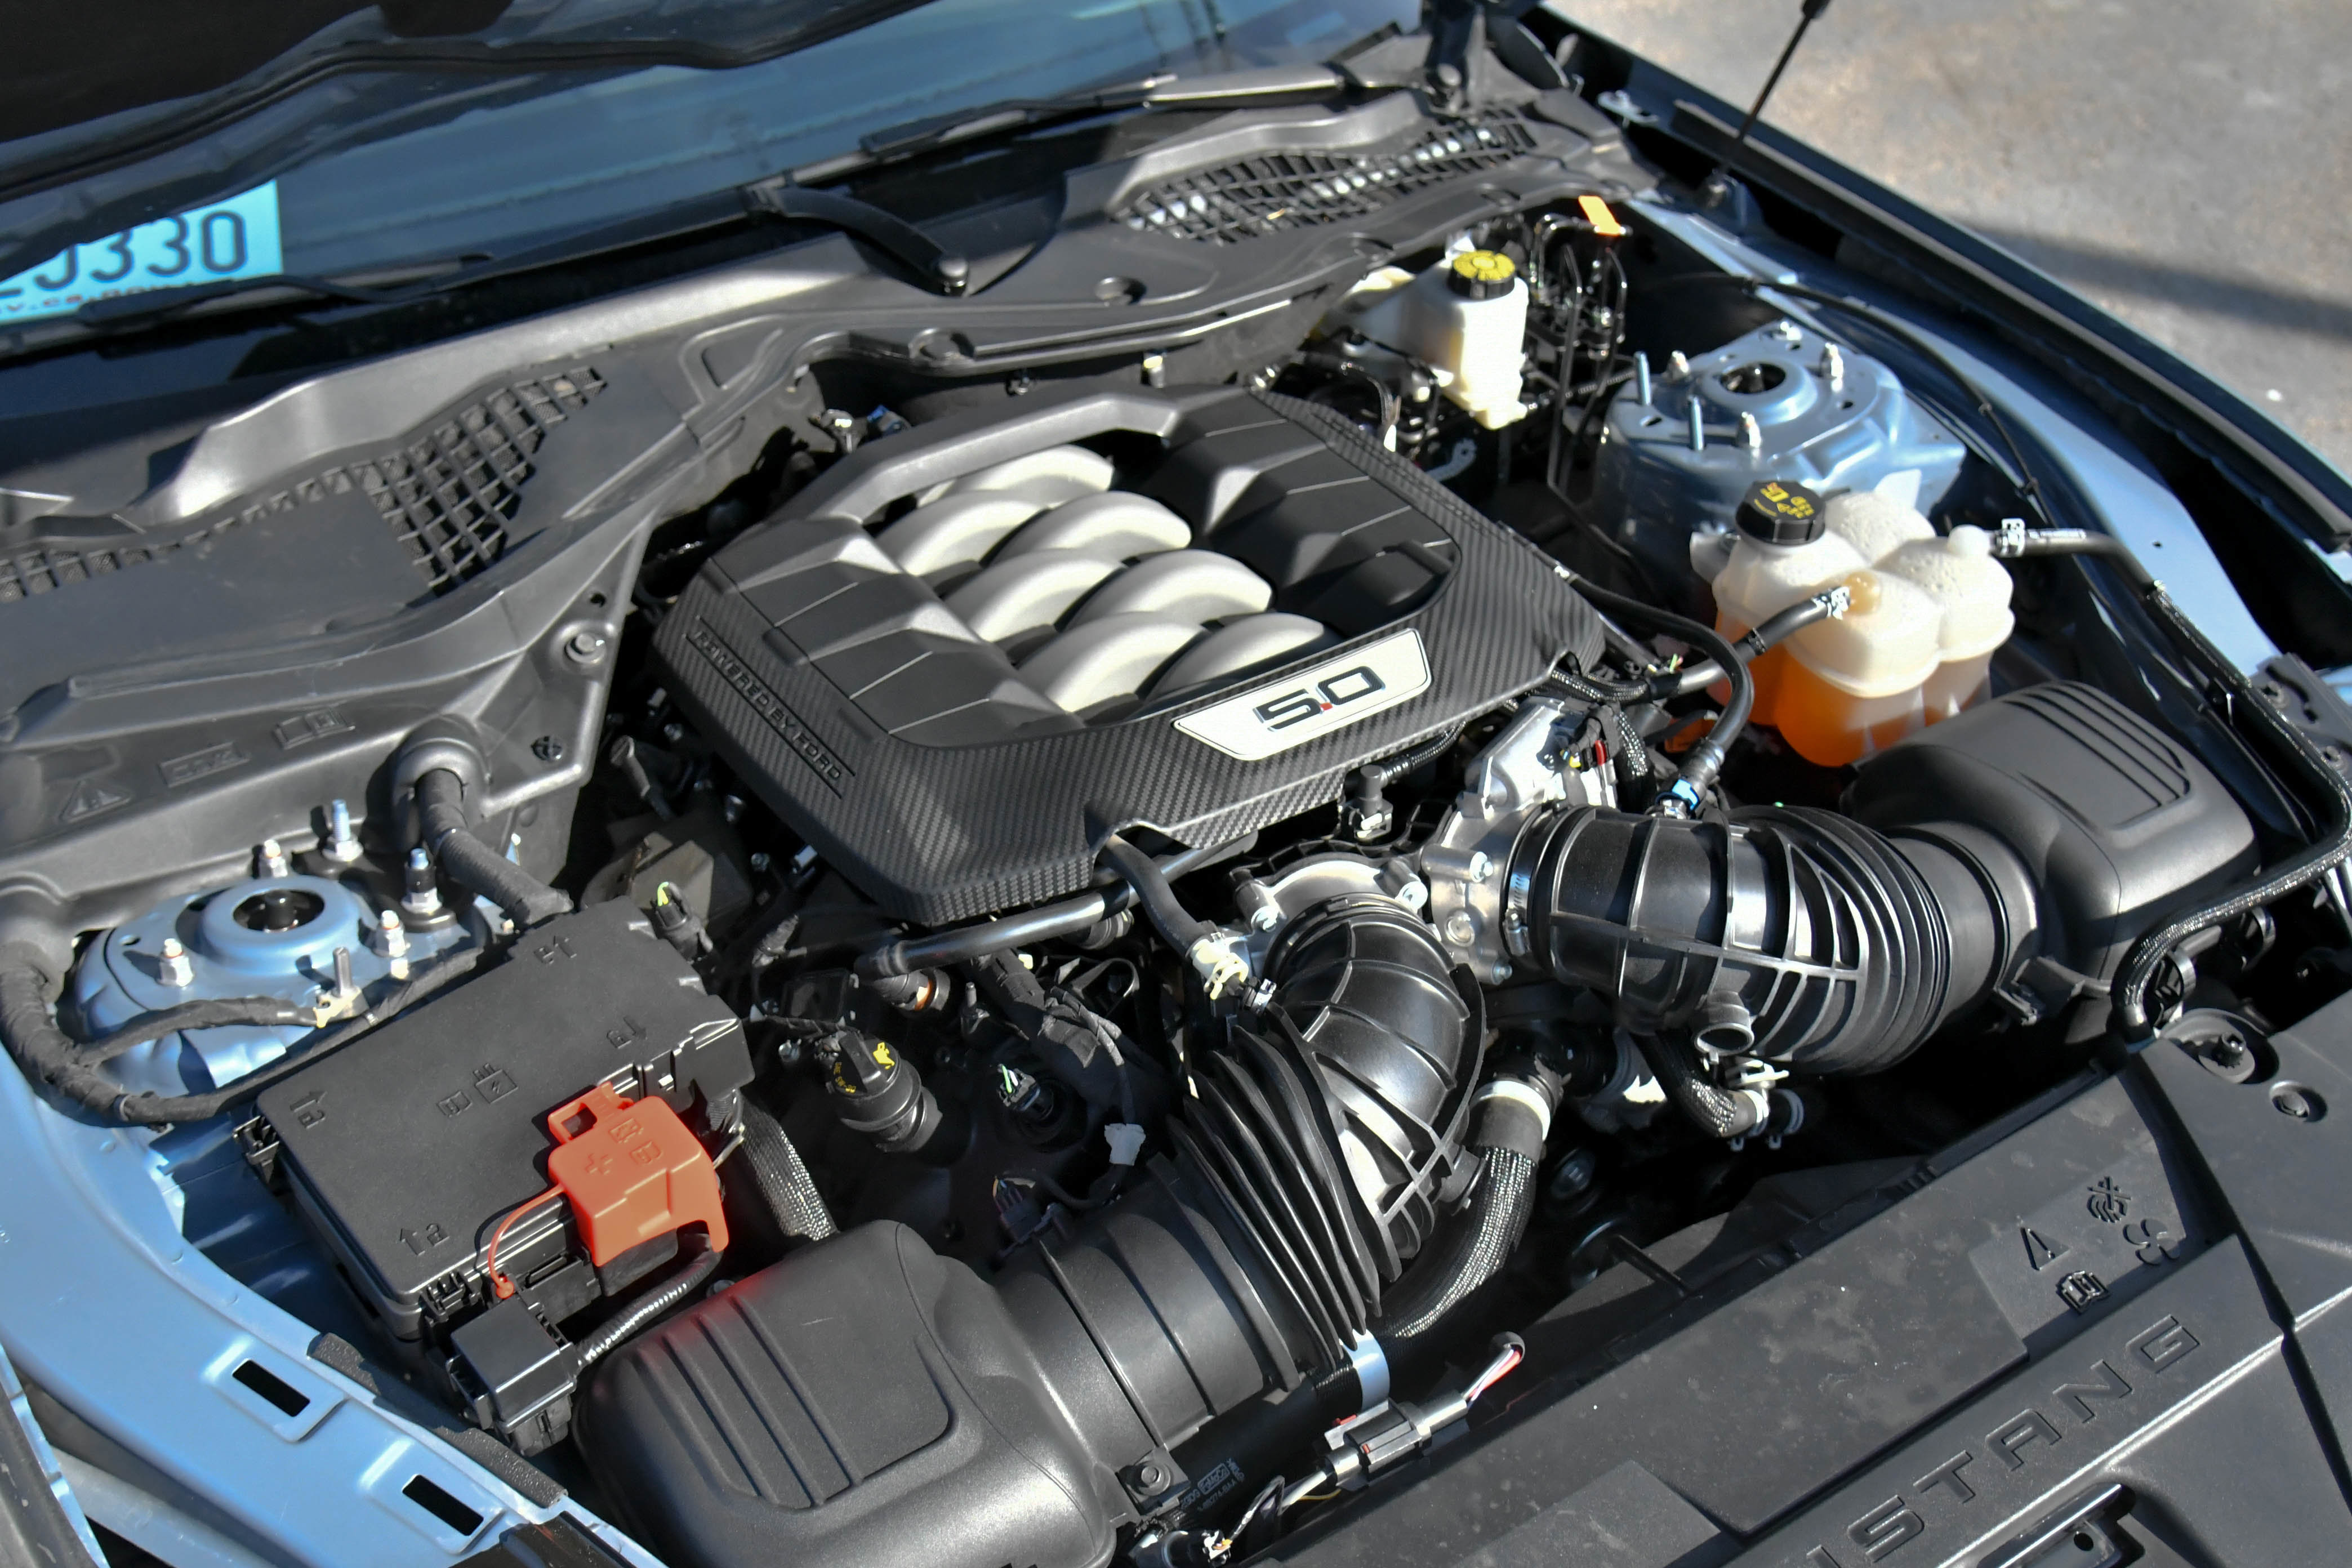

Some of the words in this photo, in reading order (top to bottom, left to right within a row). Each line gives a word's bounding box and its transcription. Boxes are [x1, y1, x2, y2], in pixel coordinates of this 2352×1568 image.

[0, 211, 249, 297] J330
[693, 630, 770, 708] POWERED
[768, 707, 796, 731] BY
[792, 732, 843, 781] FORD
[1253, 666, 1386, 732] 5.0
